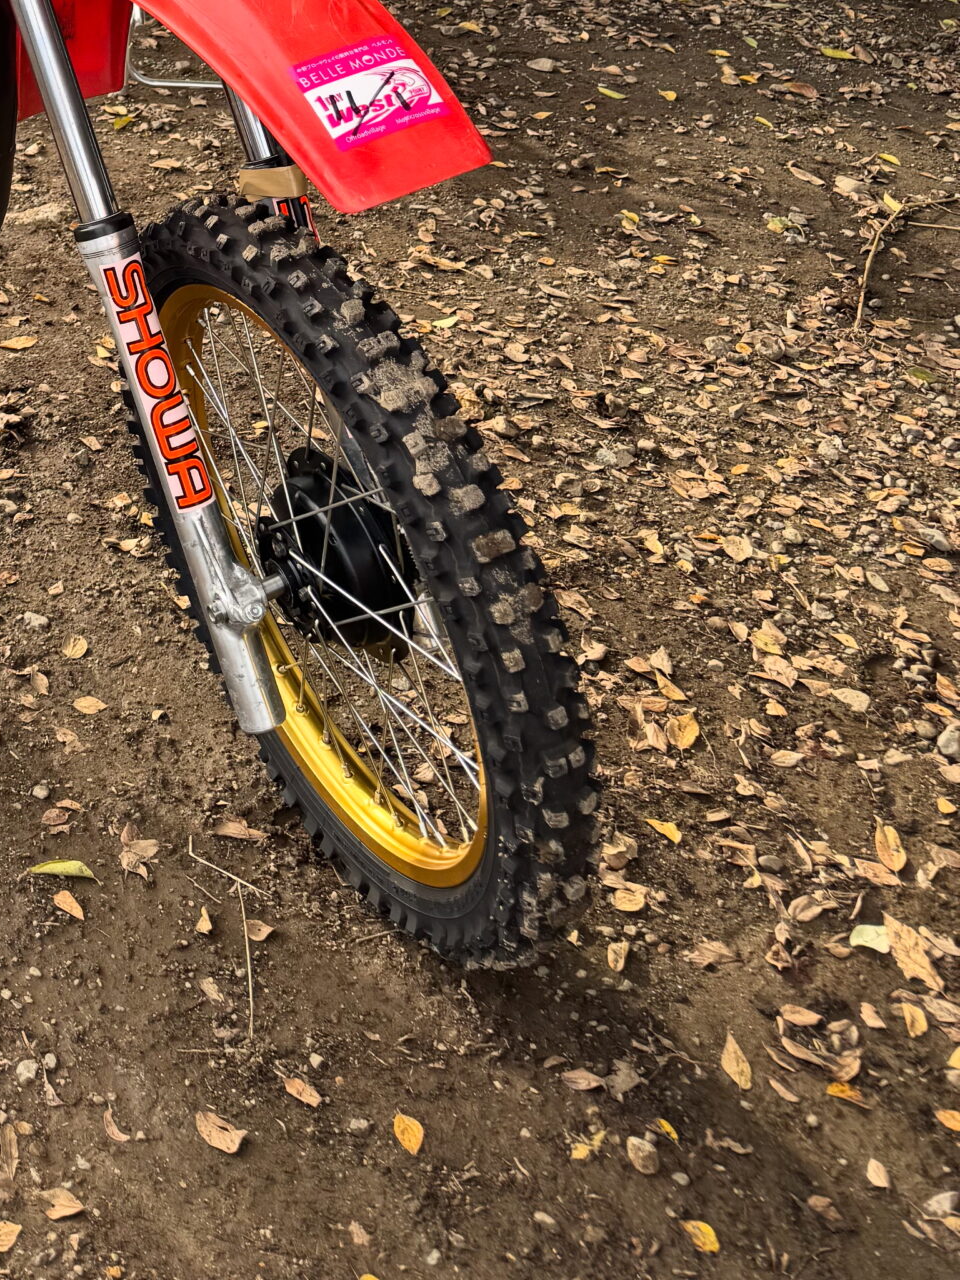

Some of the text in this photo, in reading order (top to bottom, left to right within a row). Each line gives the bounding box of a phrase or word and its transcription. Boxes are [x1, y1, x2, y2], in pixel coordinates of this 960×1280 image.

[299, 47, 406, 88] BELLE MONDE
[103, 260, 212, 510] SHOWA
